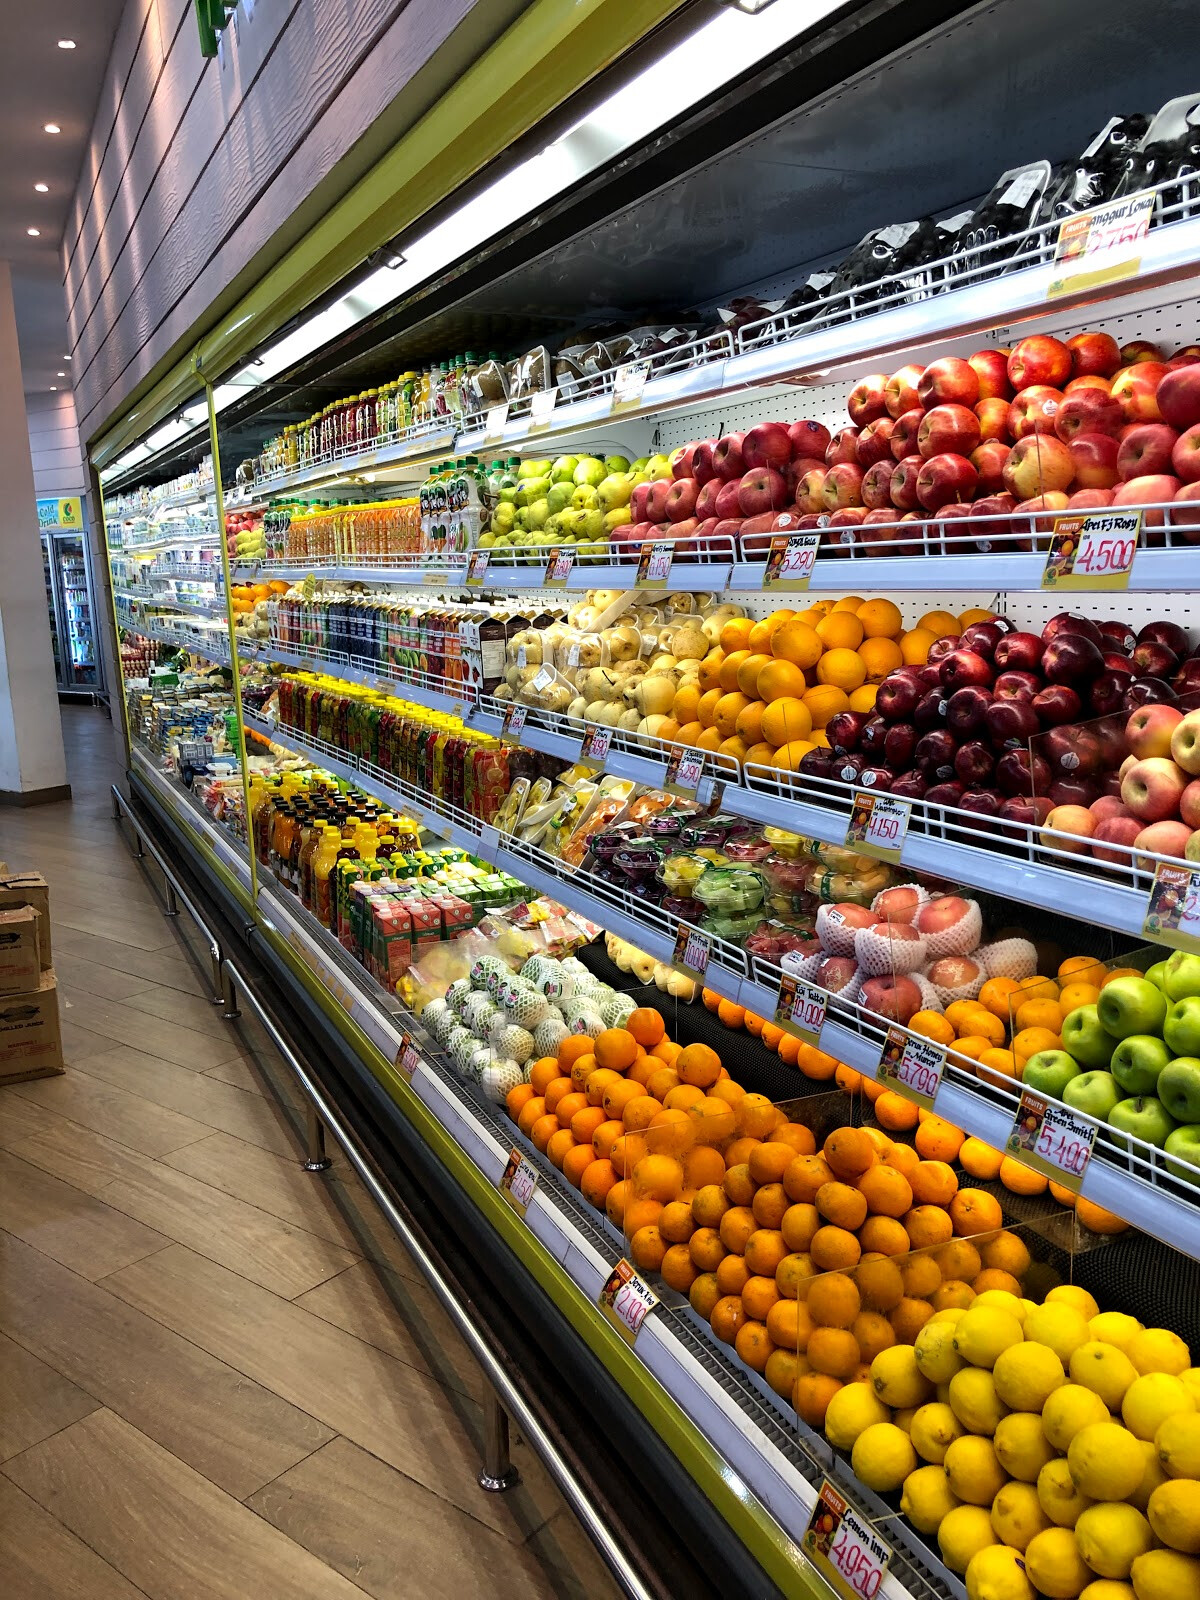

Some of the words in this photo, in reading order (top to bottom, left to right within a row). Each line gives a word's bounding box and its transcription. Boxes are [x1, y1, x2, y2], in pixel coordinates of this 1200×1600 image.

[1066, 220, 1087, 234] FRUITS
[40, 505, 54, 518] Cold
[40, 516, 58, 528] Drink
[1059, 522, 1080, 531] FRUITS
[1114, 517, 1138, 532] Rosy
[1077, 540, 1136, 573] 4.500
[869, 816, 899, 840] 4.150
[1162, 868, 1185, 880] FRUITS
[793, 998, 826, 1028] 10.000
[921, 1044, 943, 1063] Honey
[899, 1056, 939, 1095] 5.790
[1024, 1096, 1044, 1111] FRUITS
[1044, 1108, 1067, 1127] Green
[1066, 1121, 1095, 1144] Smith
[1038, 1124, 1090, 1172] 5.490
[617, 1289, 647, 1329] 2.190
[825, 1489, 842, 1511] FRUITS
[840, 1508, 870, 1545] Lemon
[870, 1535, 889, 1564] imp
[832, 1533, 883, 1598] 4.950
